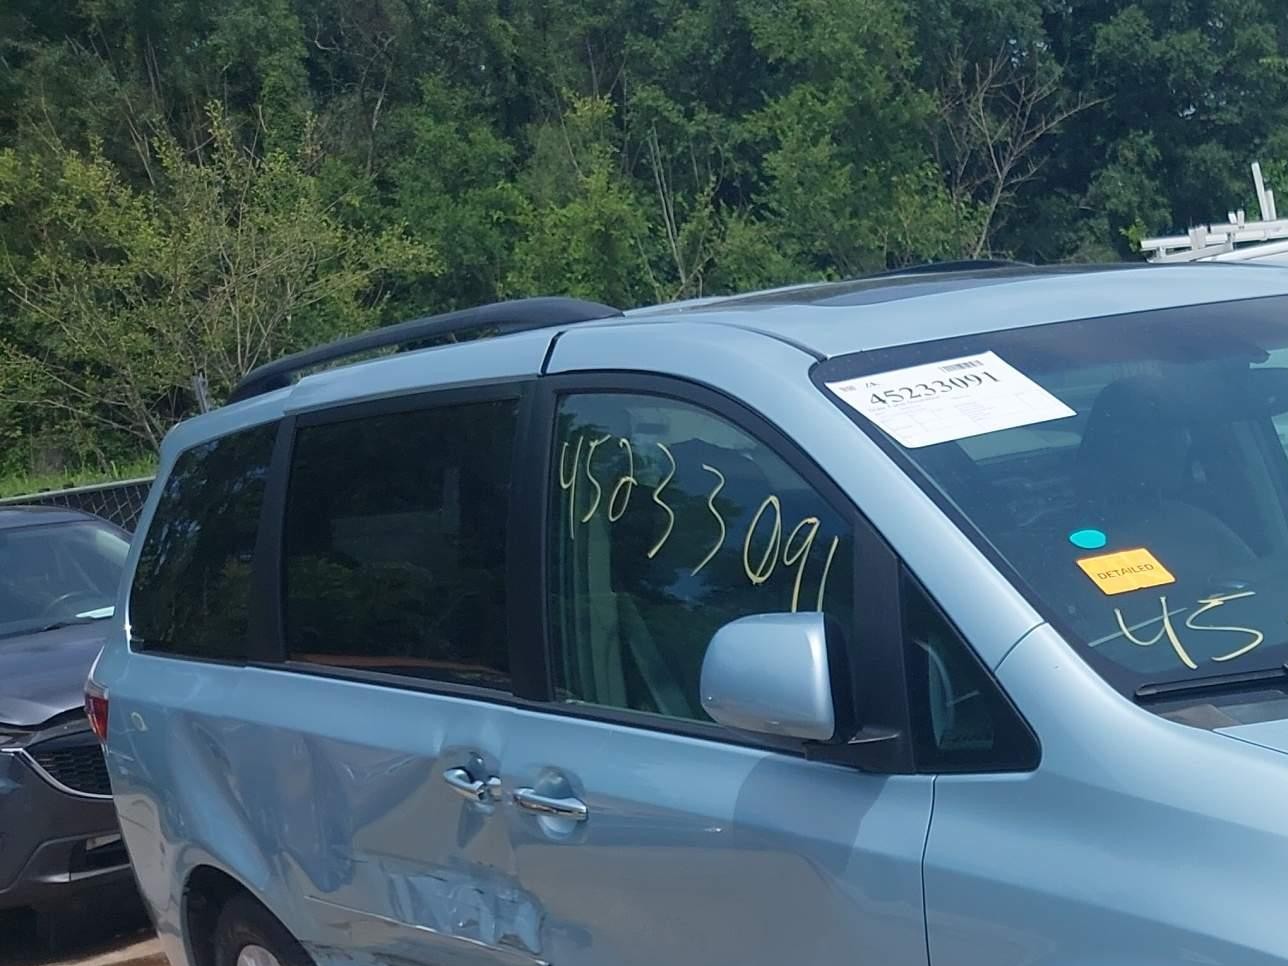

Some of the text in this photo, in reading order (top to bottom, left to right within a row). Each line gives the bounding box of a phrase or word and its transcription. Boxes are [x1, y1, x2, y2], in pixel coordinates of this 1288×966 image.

[870, 371, 1000, 405] 45233091
[560, 434, 839, 613] 45233091
[1097, 563, 1155, 580] DETAILED
